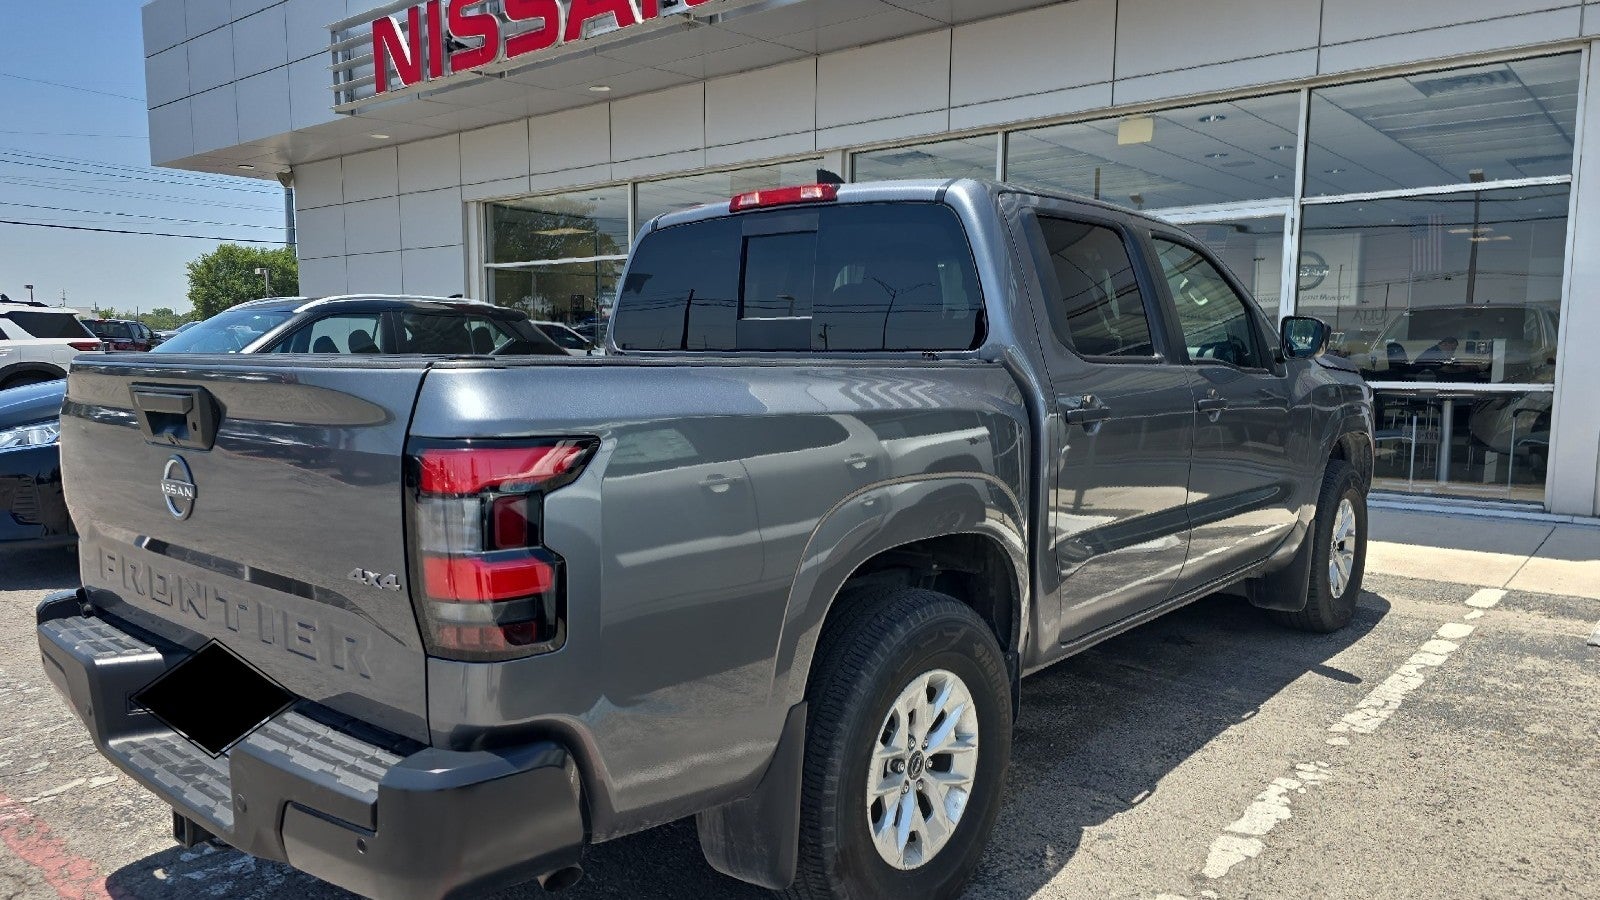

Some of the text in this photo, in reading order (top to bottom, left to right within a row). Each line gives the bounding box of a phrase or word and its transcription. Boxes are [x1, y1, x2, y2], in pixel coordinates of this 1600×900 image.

[372, 0, 712, 94] NISS
[161, 482, 193, 498] ISSAN
[100, 547, 373, 680] FRONTIER
